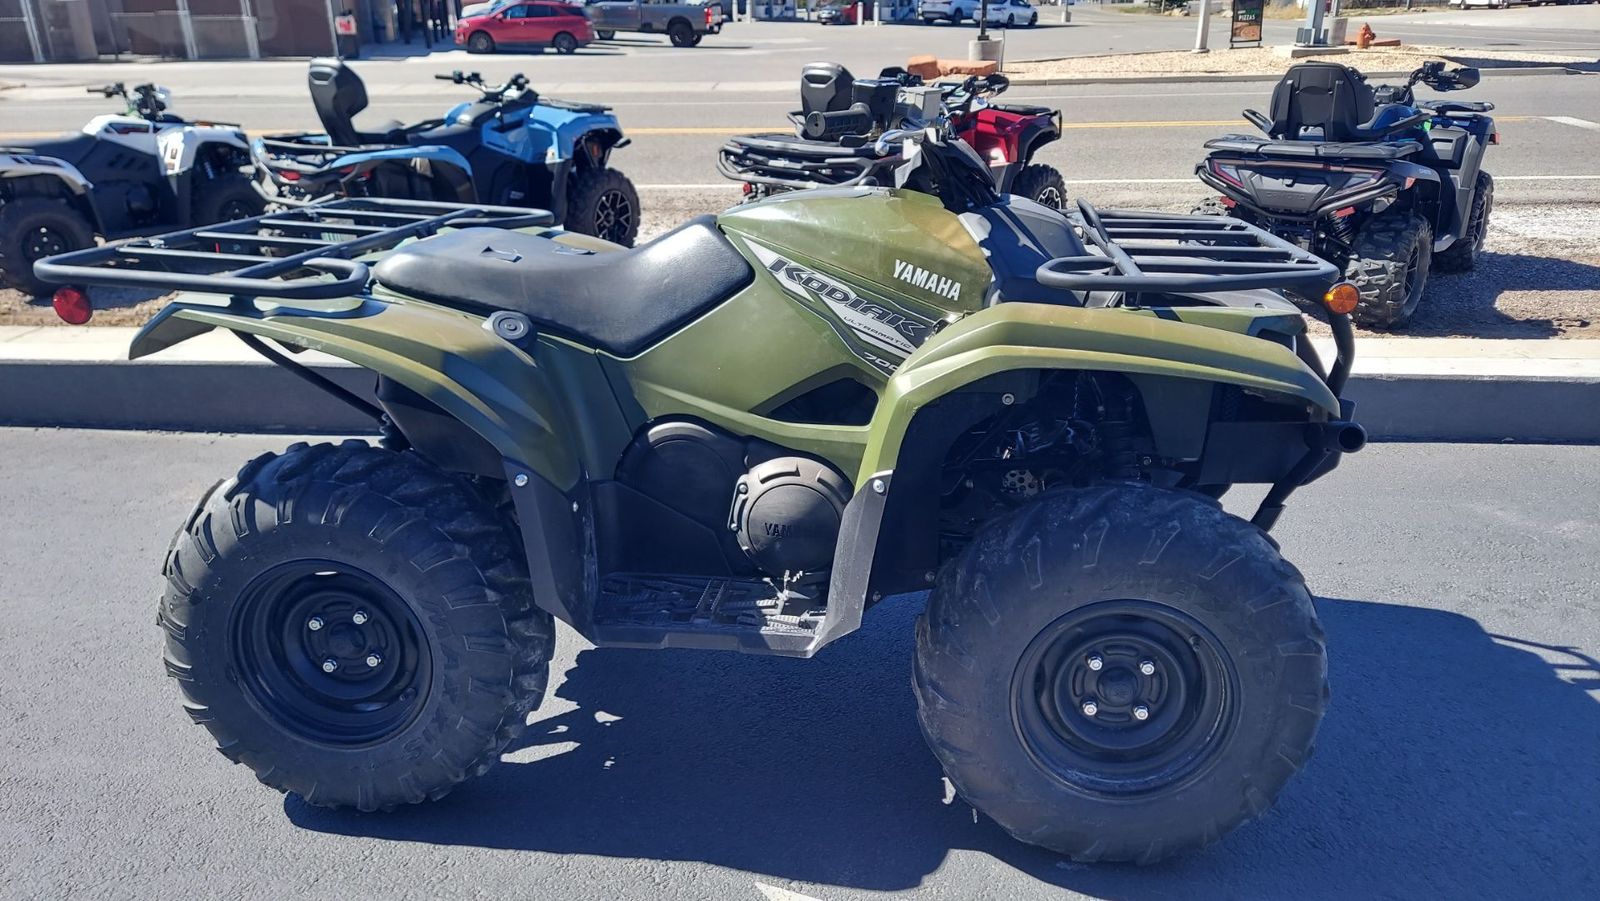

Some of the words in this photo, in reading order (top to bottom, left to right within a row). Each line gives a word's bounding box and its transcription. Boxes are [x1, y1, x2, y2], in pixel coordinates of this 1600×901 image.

[767, 258, 927, 336] KODIAK
[892, 258, 962, 302] YAMAHA
[843, 316, 912, 350] ULTRAMATIC
